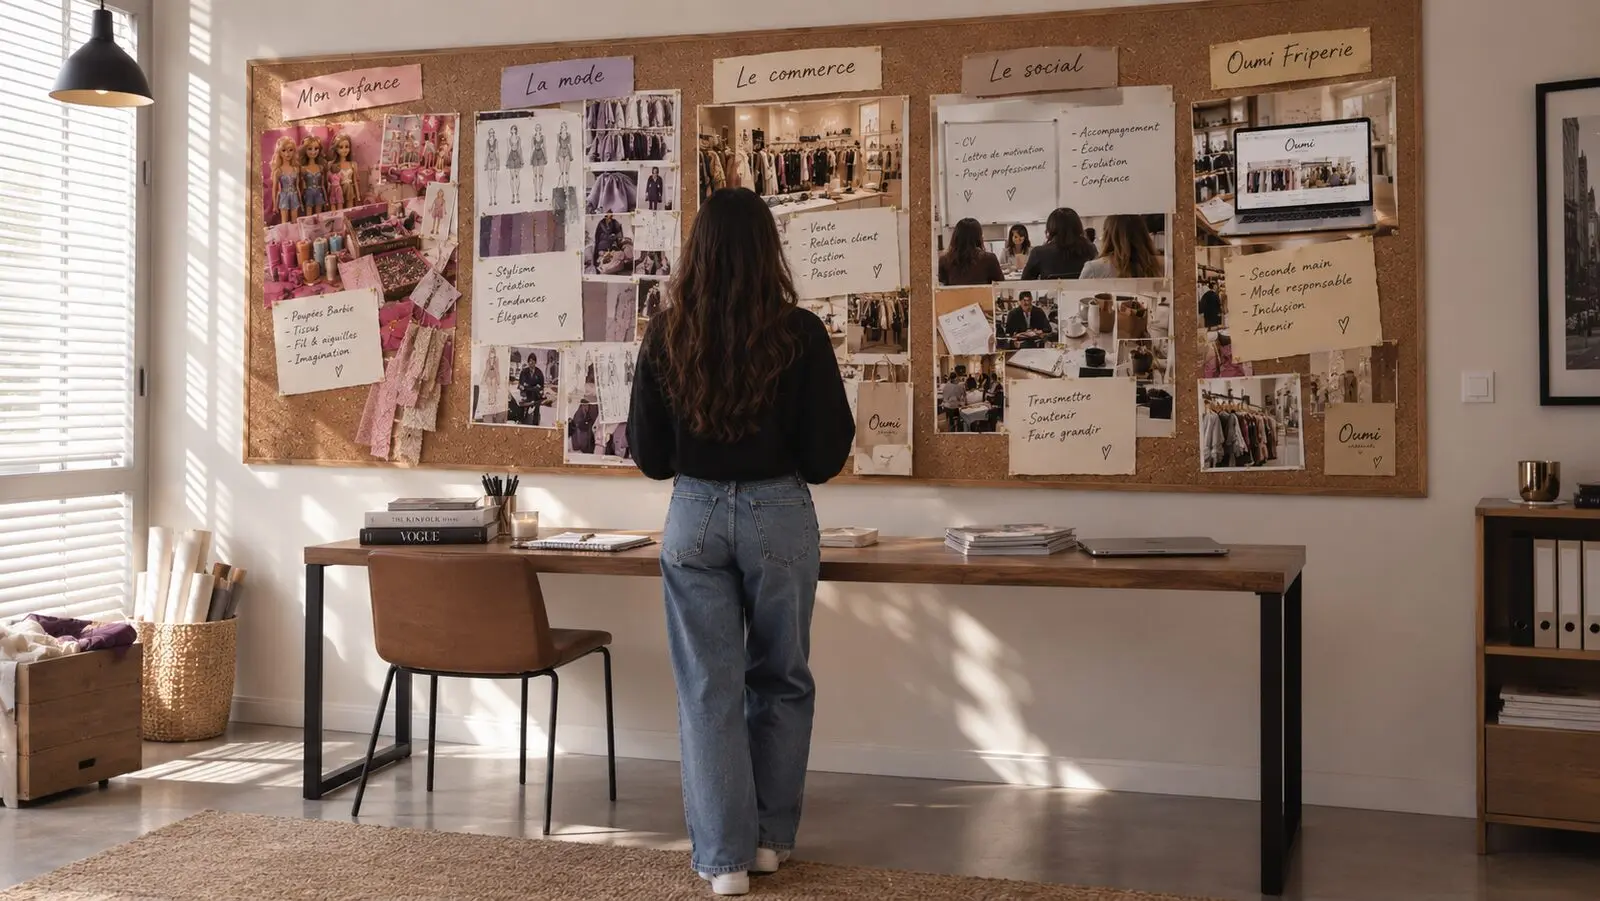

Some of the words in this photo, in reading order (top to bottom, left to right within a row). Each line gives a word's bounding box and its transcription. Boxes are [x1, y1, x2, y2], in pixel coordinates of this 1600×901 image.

[1226, 50, 1275, 75] Oumi
[1282, 42, 1353, 69] Friperie
[736, 65, 757, 89] Le
[769, 61, 856, 82] commerce
[989, 59, 1012, 83] Le
[1025, 53, 1084, 79] social
[525, 72, 548, 96] La
[558, 64, 605, 89] mode
[296, 86, 330, 109] Mon
[338, 76, 401, 101] enfance
[1079, 122, 1161, 138] Accompagnement
[962, 135, 977, 147] CV
[1284, 137, 1315, 152] Oumi
[962, 152, 988, 164] Lettre
[990, 149, 1000, 159] de
[1003, 144, 1045, 157] motivation
[991, 160, 1047, 178] professionnel
[1081, 174, 1130, 188] Confiance
[810, 221, 837, 234] Vente
[809, 236, 847, 249] Relation
[851, 231, 879, 244] client
[810, 252, 845, 265] Gestion
[495, 264, 536, 279] Stylisme
[810, 267, 848, 280] Passion
[1249, 262, 1297, 282] Seconde
[1302, 258, 1333, 272] main
[1250, 284, 1281, 300] Mode
[1286, 273, 1354, 294] responsable
[497, 294, 547, 308] Tendances
[1252, 301, 1307, 318] Inclusion
[326, 304, 355, 317] Barbie
[294, 324, 320, 336] Tissus
[1253, 320, 1294, 336] Avenir
[294, 337, 307, 350] Fil
[311, 337, 318, 346] &
[322, 331, 358, 346] aiguilles
[294, 348, 350, 366] Imagination
[1027, 391, 1094, 408] Transmettre
[868, 413, 902, 431] Oumi
[1029, 410, 1077, 425] Soutenir
[1027, 428, 1056, 443] Faire
[1060, 425, 1102, 442] grandir
[1338, 422, 1382, 444] Oumi
[400, 531, 440, 542] VOGUE
